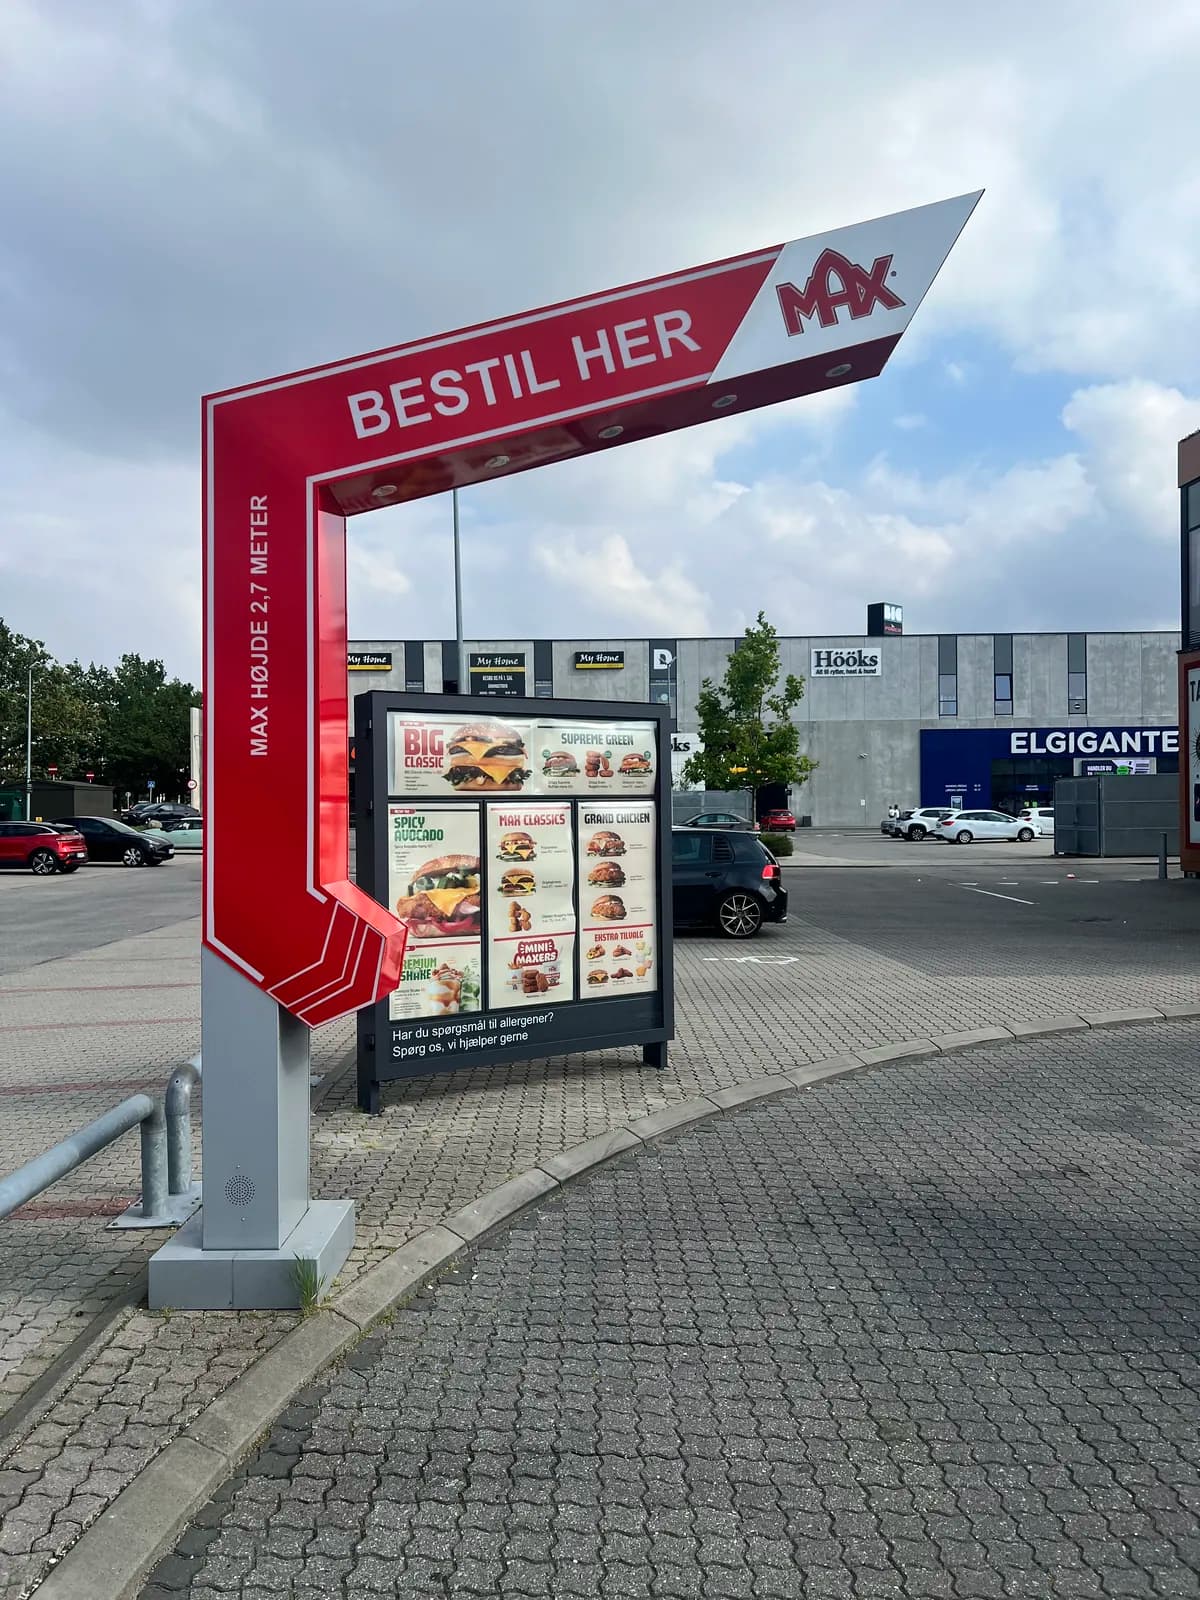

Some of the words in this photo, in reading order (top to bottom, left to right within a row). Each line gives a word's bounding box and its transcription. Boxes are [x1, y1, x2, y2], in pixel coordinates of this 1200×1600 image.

[775, 247, 906, 337] MAX
[347, 350, 560, 440] BESTIL
[571, 309, 702, 381] HER
[250, 495, 268, 575] METER
[250, 582, 271, 613] 2,7
[250, 621, 269, 699] HØJDE
[347, 655, 361, 665] My
[363, 655, 387, 663] Home
[476, 657, 491, 668] My
[494, 656, 519, 665] Home
[580, 654, 594, 664] My
[595, 653, 620, 662] Home
[814, 649, 878, 667] Hööks
[250, 706, 268, 756] MAX
[404, 729, 444, 755] BIG
[561, 733, 604, 745] SUPREME
[606, 735, 634, 745] GREEN
[671, 737, 690, 752] ks
[1010, 731, 1179, 754] ELGIGANTE
[404, 757, 444, 768] CLASSIC
[394, 817, 425, 828] SPICY
[499, 815, 520, 826] MAX
[524, 814, 565, 826] CLASSICS
[584, 813, 614, 824] GRAND
[617, 813, 650, 824] CHICKEN
[394, 829, 444, 841] AVOCADO
[594, 933, 619, 942] EKSTRA
[620, 931, 644, 940] TILVALG
[525, 943, 549, 953] MINI
[516, 952, 557, 964] MAXERS
[400, 969, 432, 981] SHAKE
[392, 1029, 413, 1041] Har
[415, 1027, 429, 1038] du
[431, 1020, 486, 1038] spørgsmål
[489, 1018, 497, 1029] til
[500, 1011, 554, 1029] allergener?
[392, 1045, 426, 1059] Spørg
[428, 1042, 445, 1053] os,
[447, 1038, 457, 1050] vi
[459, 1033, 498, 1050] hjælper
[500, 1031, 529, 1045] gerne
